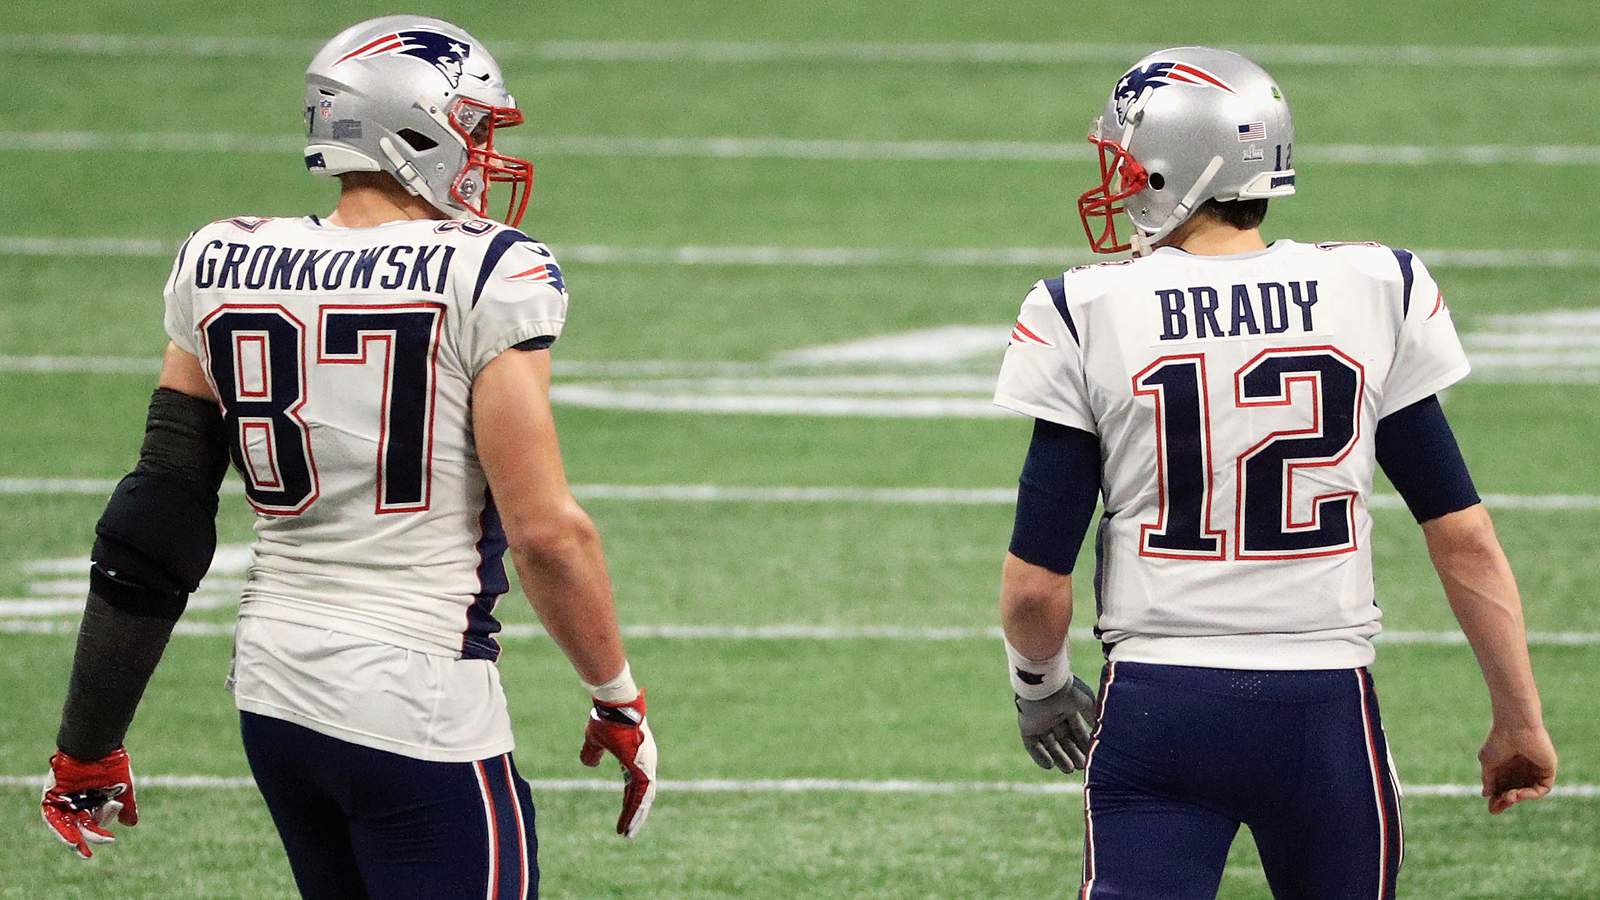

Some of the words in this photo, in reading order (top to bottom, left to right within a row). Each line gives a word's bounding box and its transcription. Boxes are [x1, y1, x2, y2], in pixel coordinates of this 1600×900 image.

[195, 239, 456, 295] GRONKOWSKI
[1155, 280, 1318, 340] BRADY
[199, 303, 447, 515] 87
[1132, 345, 1364, 560] 12
